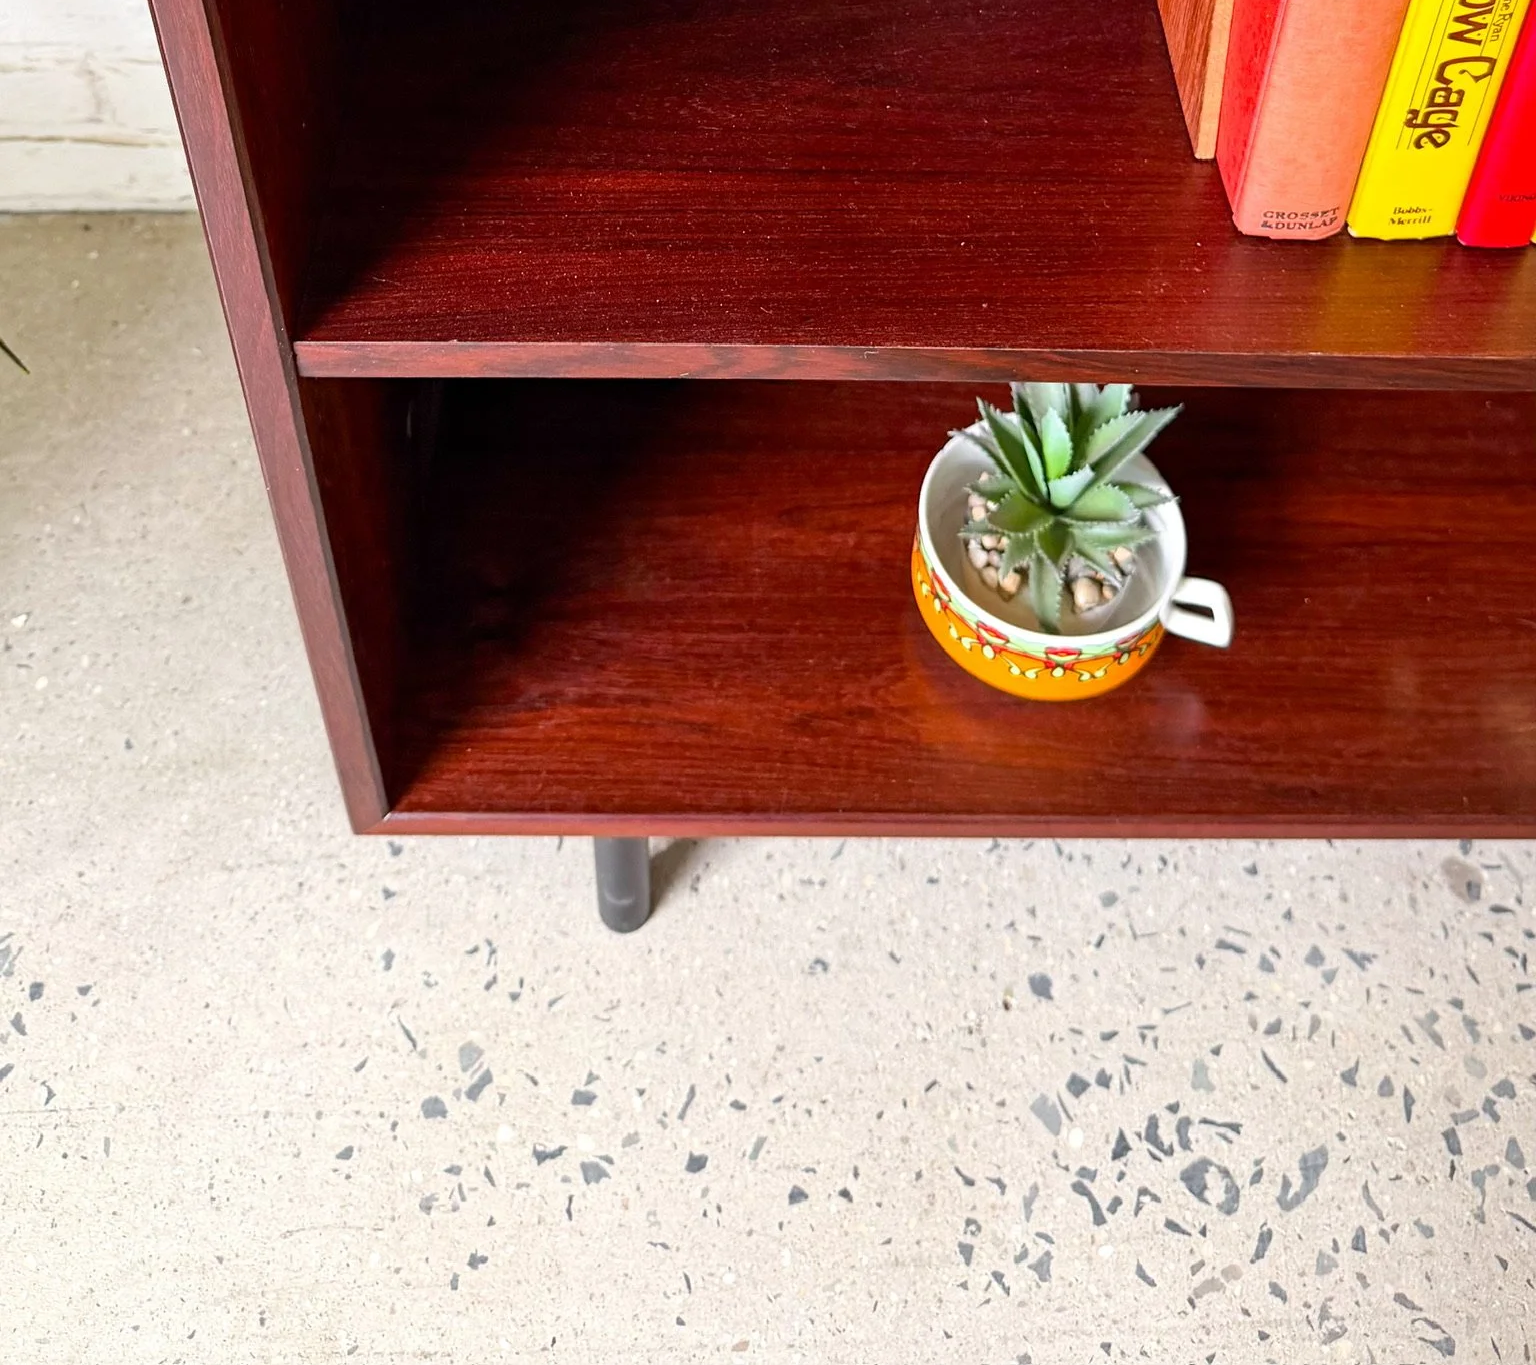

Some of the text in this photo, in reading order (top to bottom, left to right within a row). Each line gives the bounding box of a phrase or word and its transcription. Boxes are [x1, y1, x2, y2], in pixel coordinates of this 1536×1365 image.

[1490, 12, 1514, 42] Ryan
[1403, 55, 1498, 149] Cage
[1263, 206, 1340, 220] GROSSET
